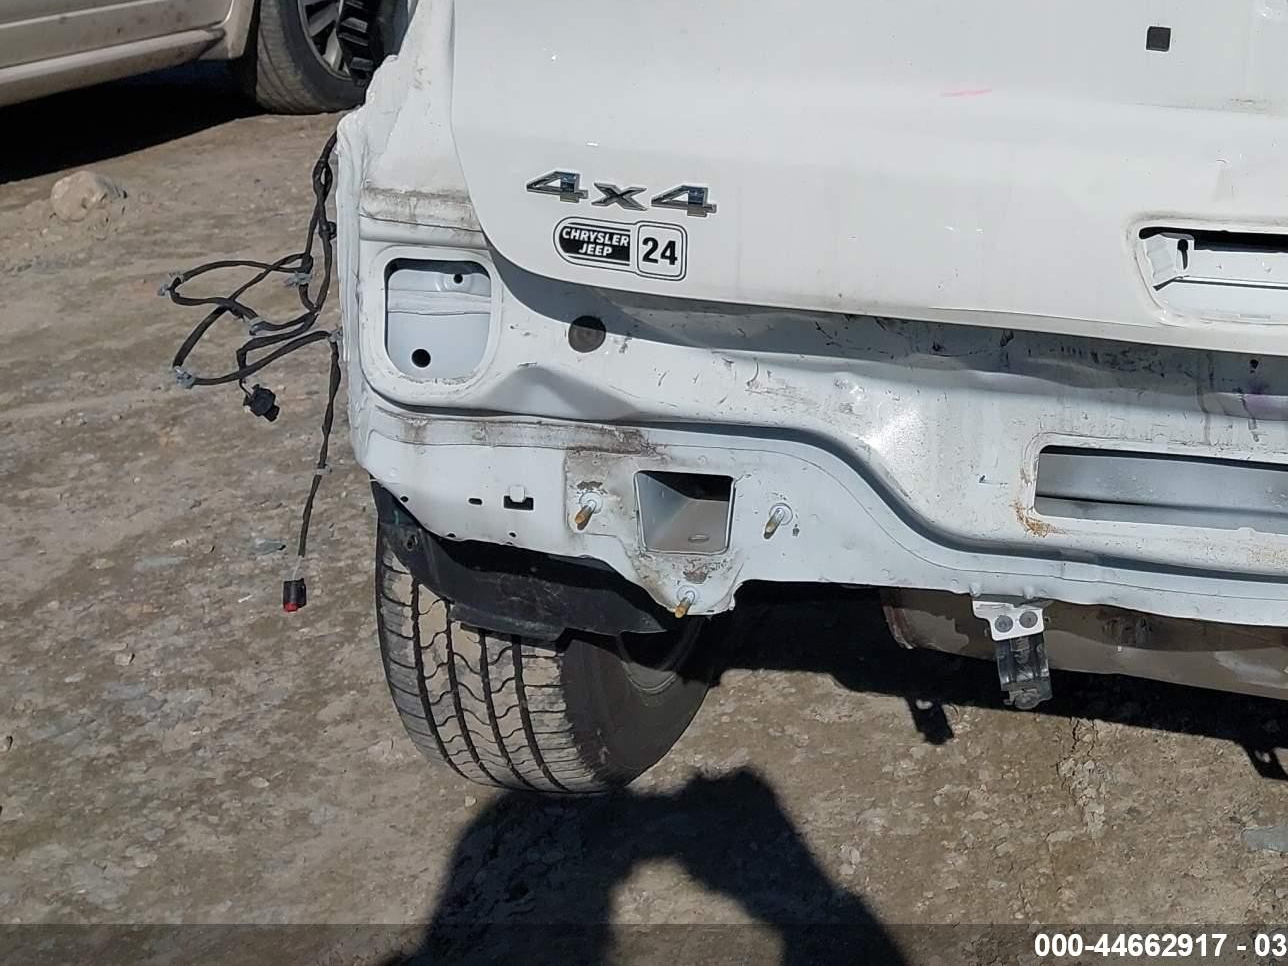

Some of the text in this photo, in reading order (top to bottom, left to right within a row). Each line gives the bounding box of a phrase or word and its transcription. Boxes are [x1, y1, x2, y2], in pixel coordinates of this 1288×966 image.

[526, 170, 717, 217] 4x4
[562, 228, 630, 247] CHRYSLER
[579, 243, 613, 257] JEEP
[641, 237, 678, 265] 24
